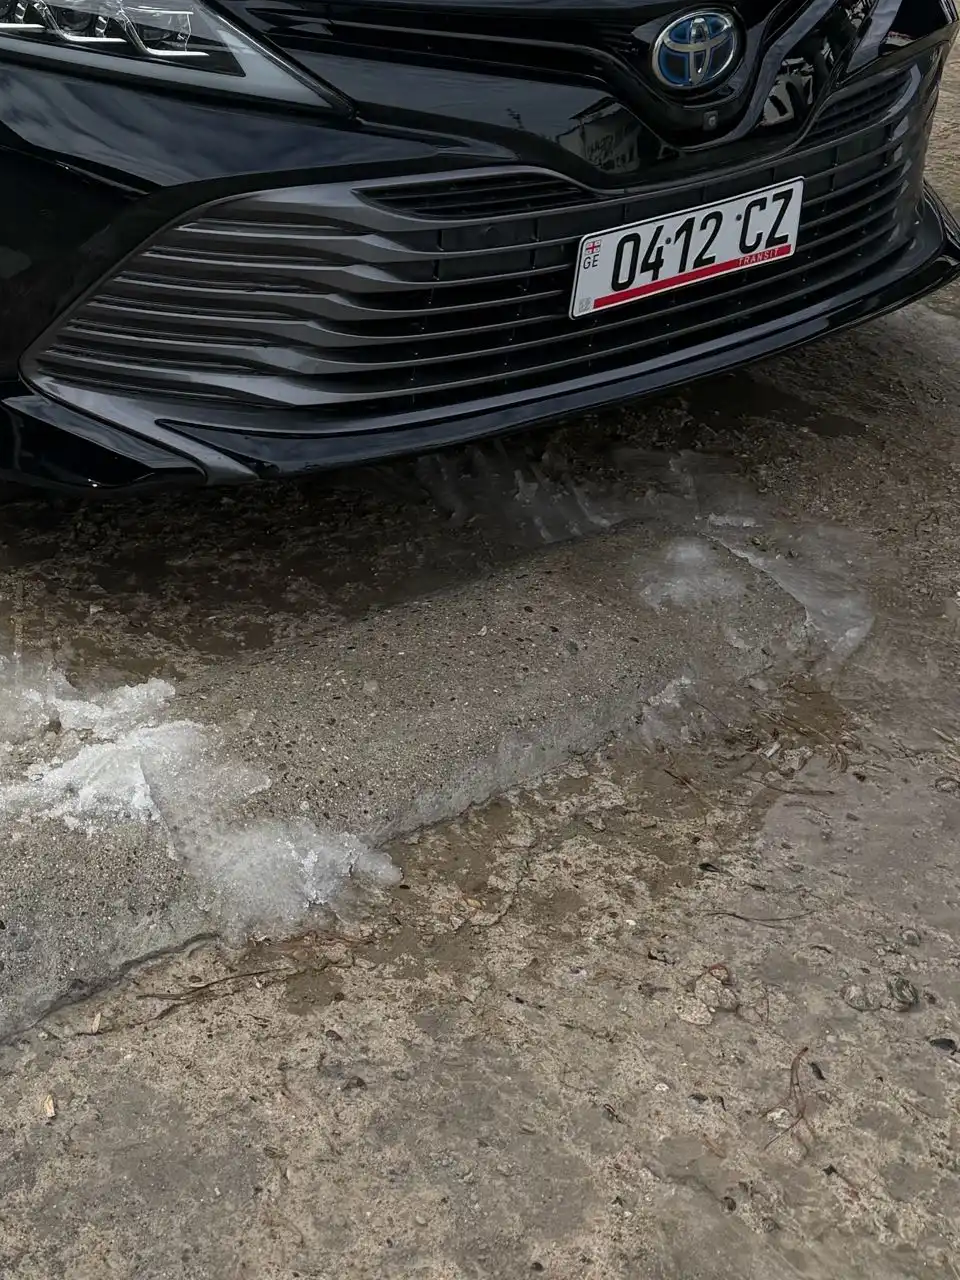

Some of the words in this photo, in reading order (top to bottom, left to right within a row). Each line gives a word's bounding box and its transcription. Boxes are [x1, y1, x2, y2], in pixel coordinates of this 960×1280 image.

[611, 210, 724, 292] 0412
[739, 187, 795, 254] CZ
[583, 253, 600, 270] GE
[739, 248, 780, 267] TRANSIT
